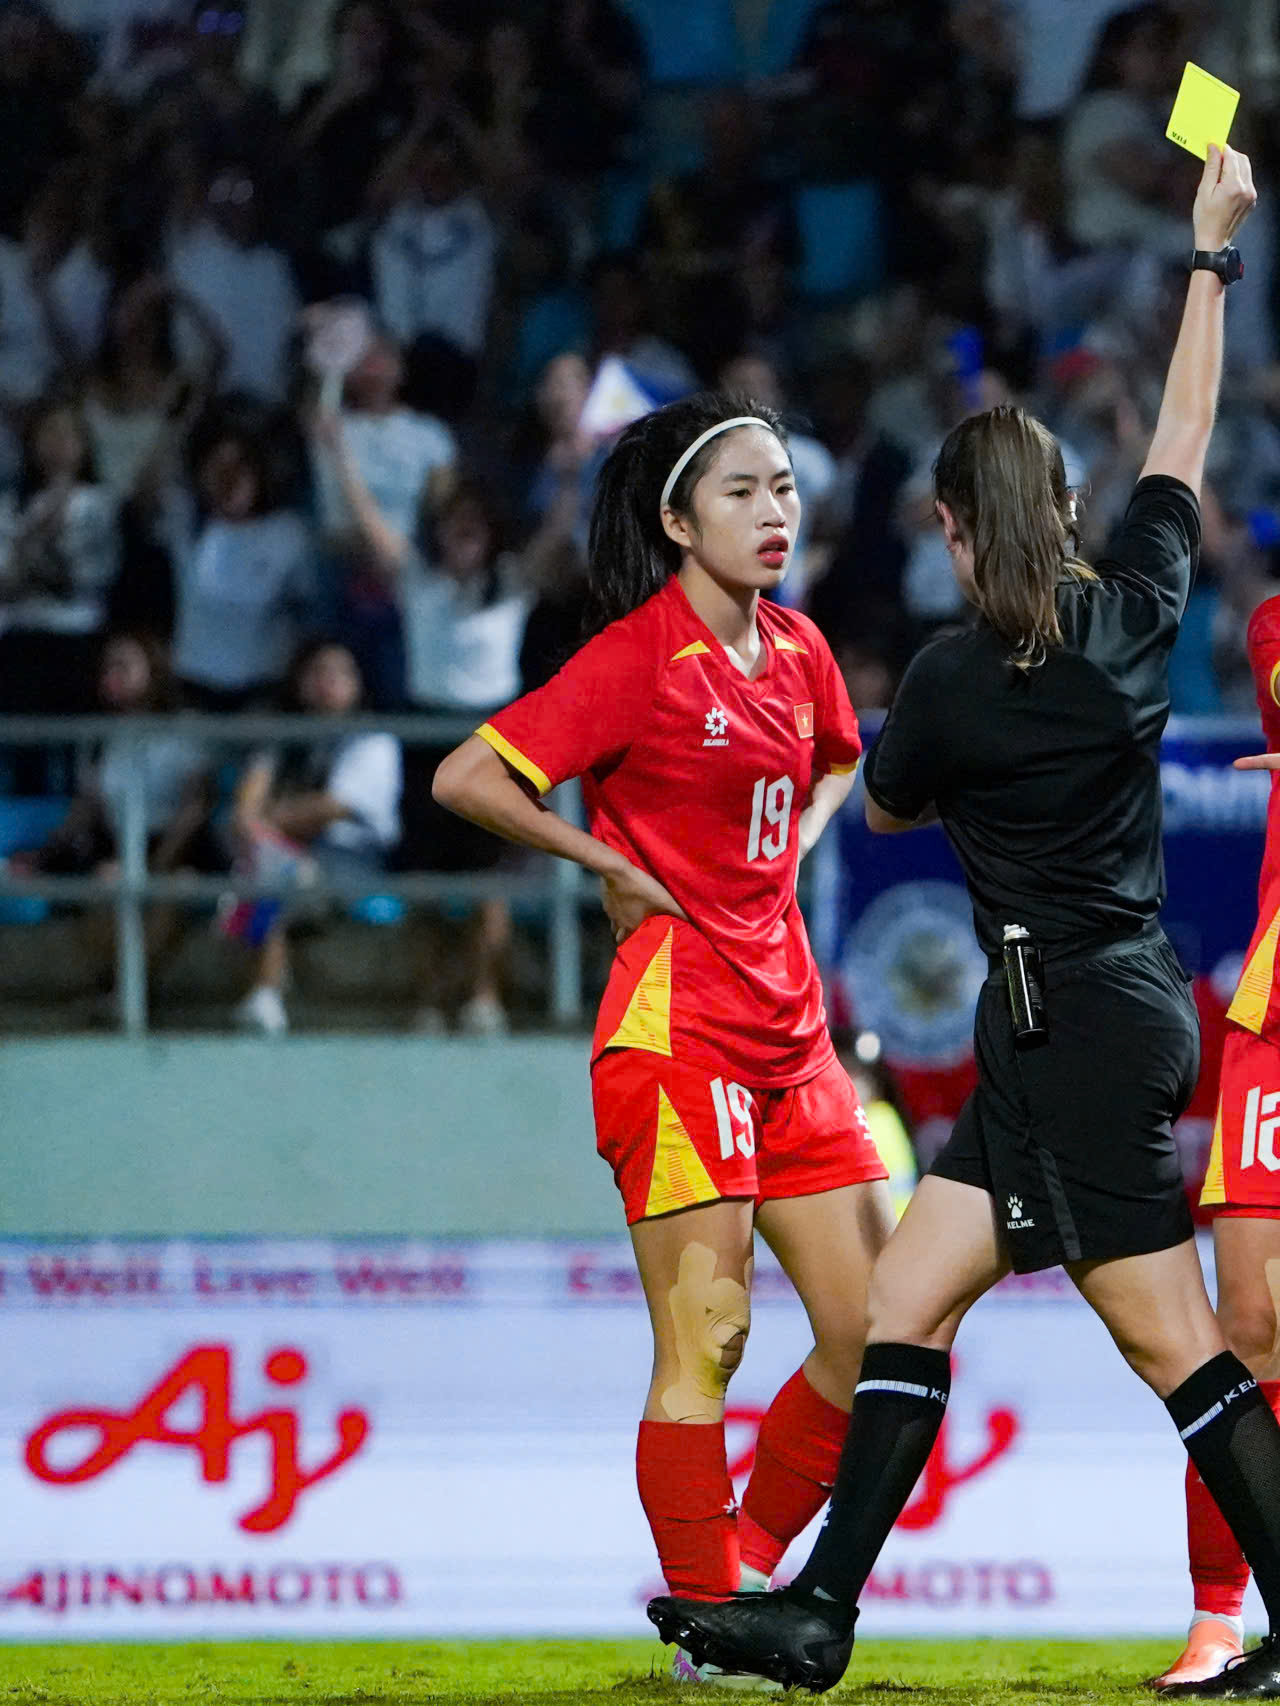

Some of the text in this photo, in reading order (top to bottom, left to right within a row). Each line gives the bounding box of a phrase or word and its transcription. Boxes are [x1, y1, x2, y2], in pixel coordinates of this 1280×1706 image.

[747, 774, 795, 863] 19
[709, 1076, 756, 1161] 19
[1006, 1218, 1036, 1230] KELME
[2, 1564, 403, 1612] AJINOMOTO
